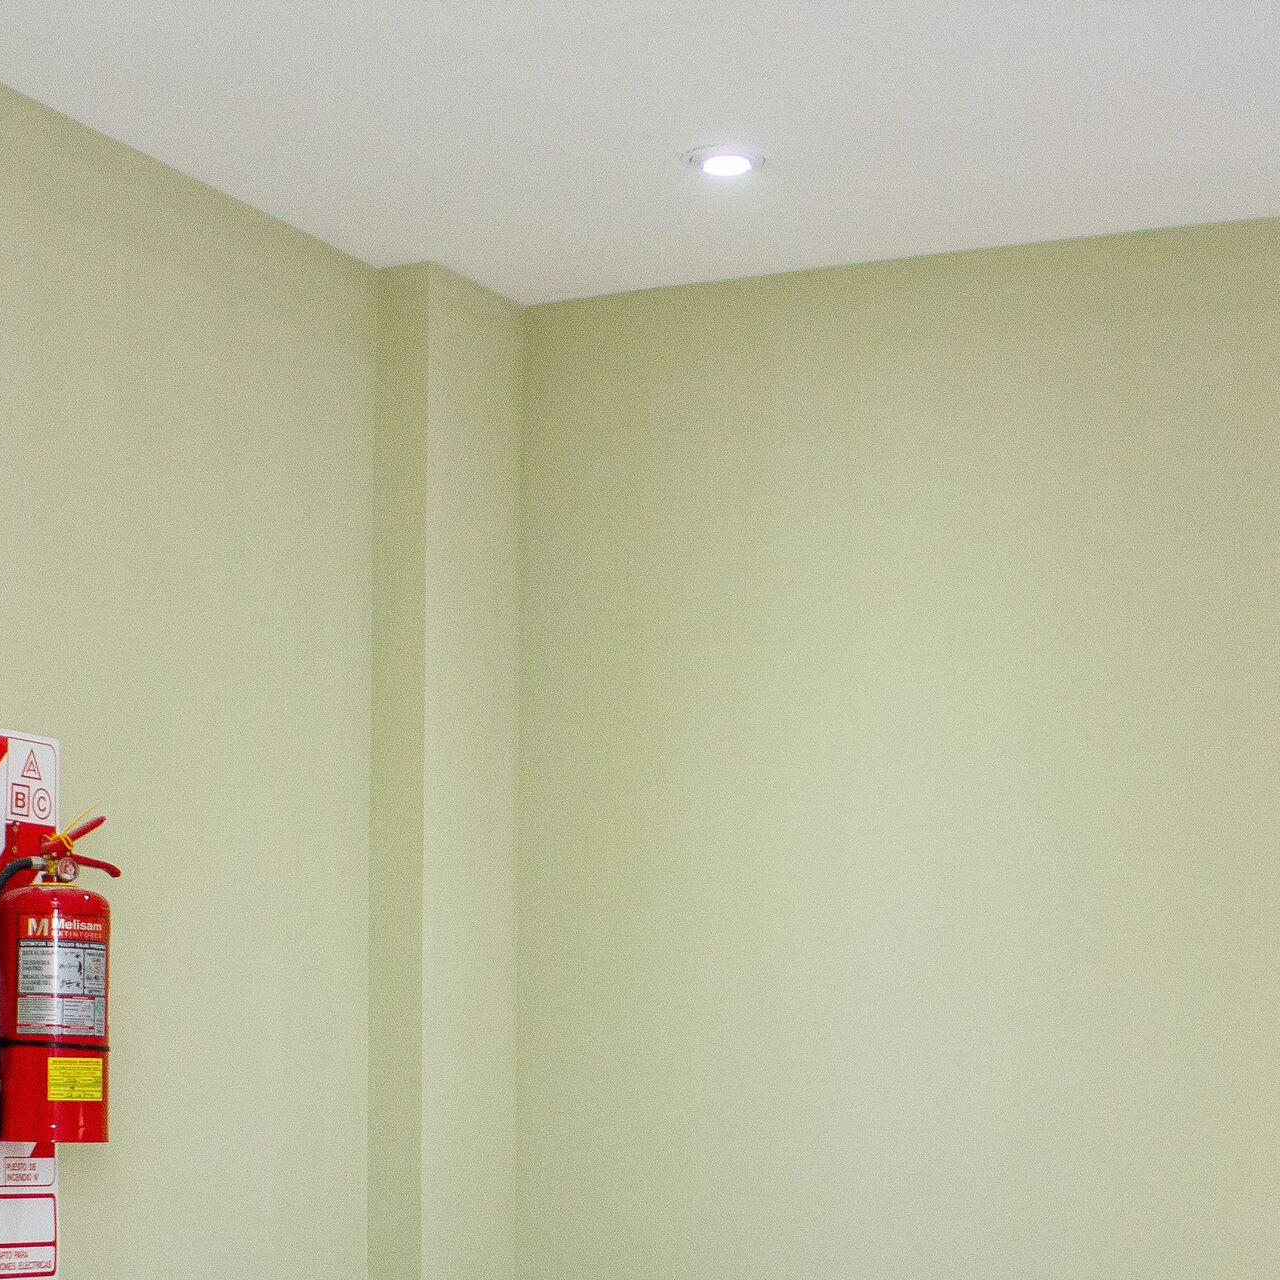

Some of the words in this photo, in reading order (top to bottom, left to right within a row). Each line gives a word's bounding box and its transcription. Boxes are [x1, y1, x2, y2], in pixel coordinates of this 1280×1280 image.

[26, 760, 37, 774] A
[15, 791, 26, 808] B
[37, 796, 47, 812] C
[27, 917, 49, 936] M
